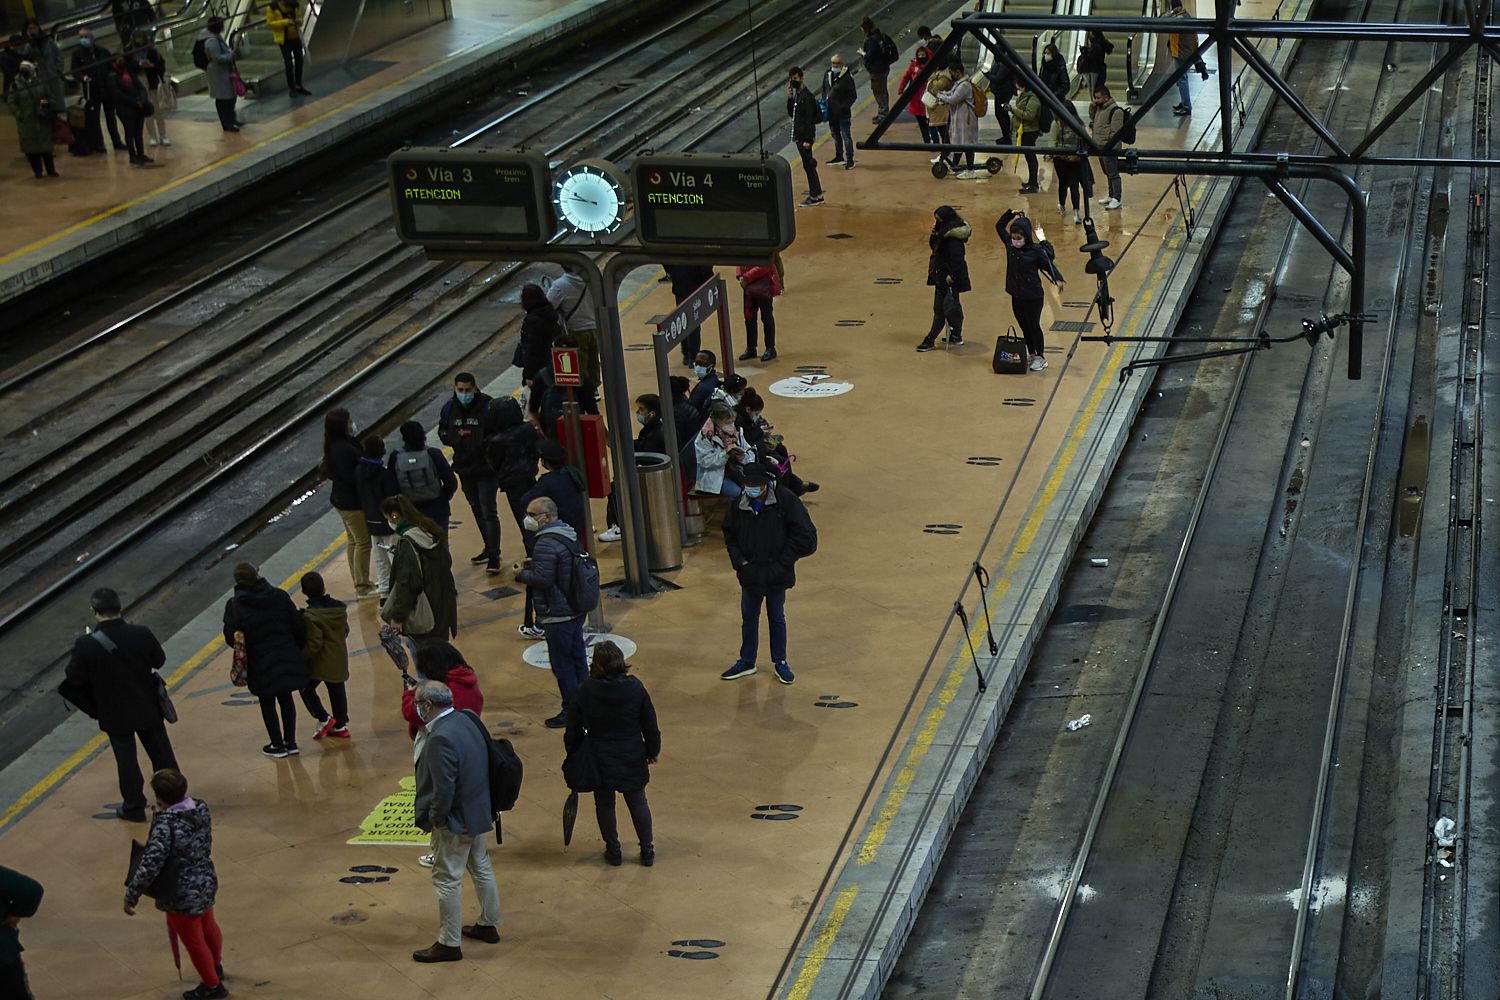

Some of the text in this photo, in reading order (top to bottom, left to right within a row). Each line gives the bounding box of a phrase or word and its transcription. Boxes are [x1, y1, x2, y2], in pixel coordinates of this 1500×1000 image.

[427, 167, 473, 183] Vía 3
[669, 171, 714, 188] Vía 4
[747, 181, 763, 189] tren
[404, 188, 462, 200] ATENCION
[647, 193, 704, 205] ATENCION
